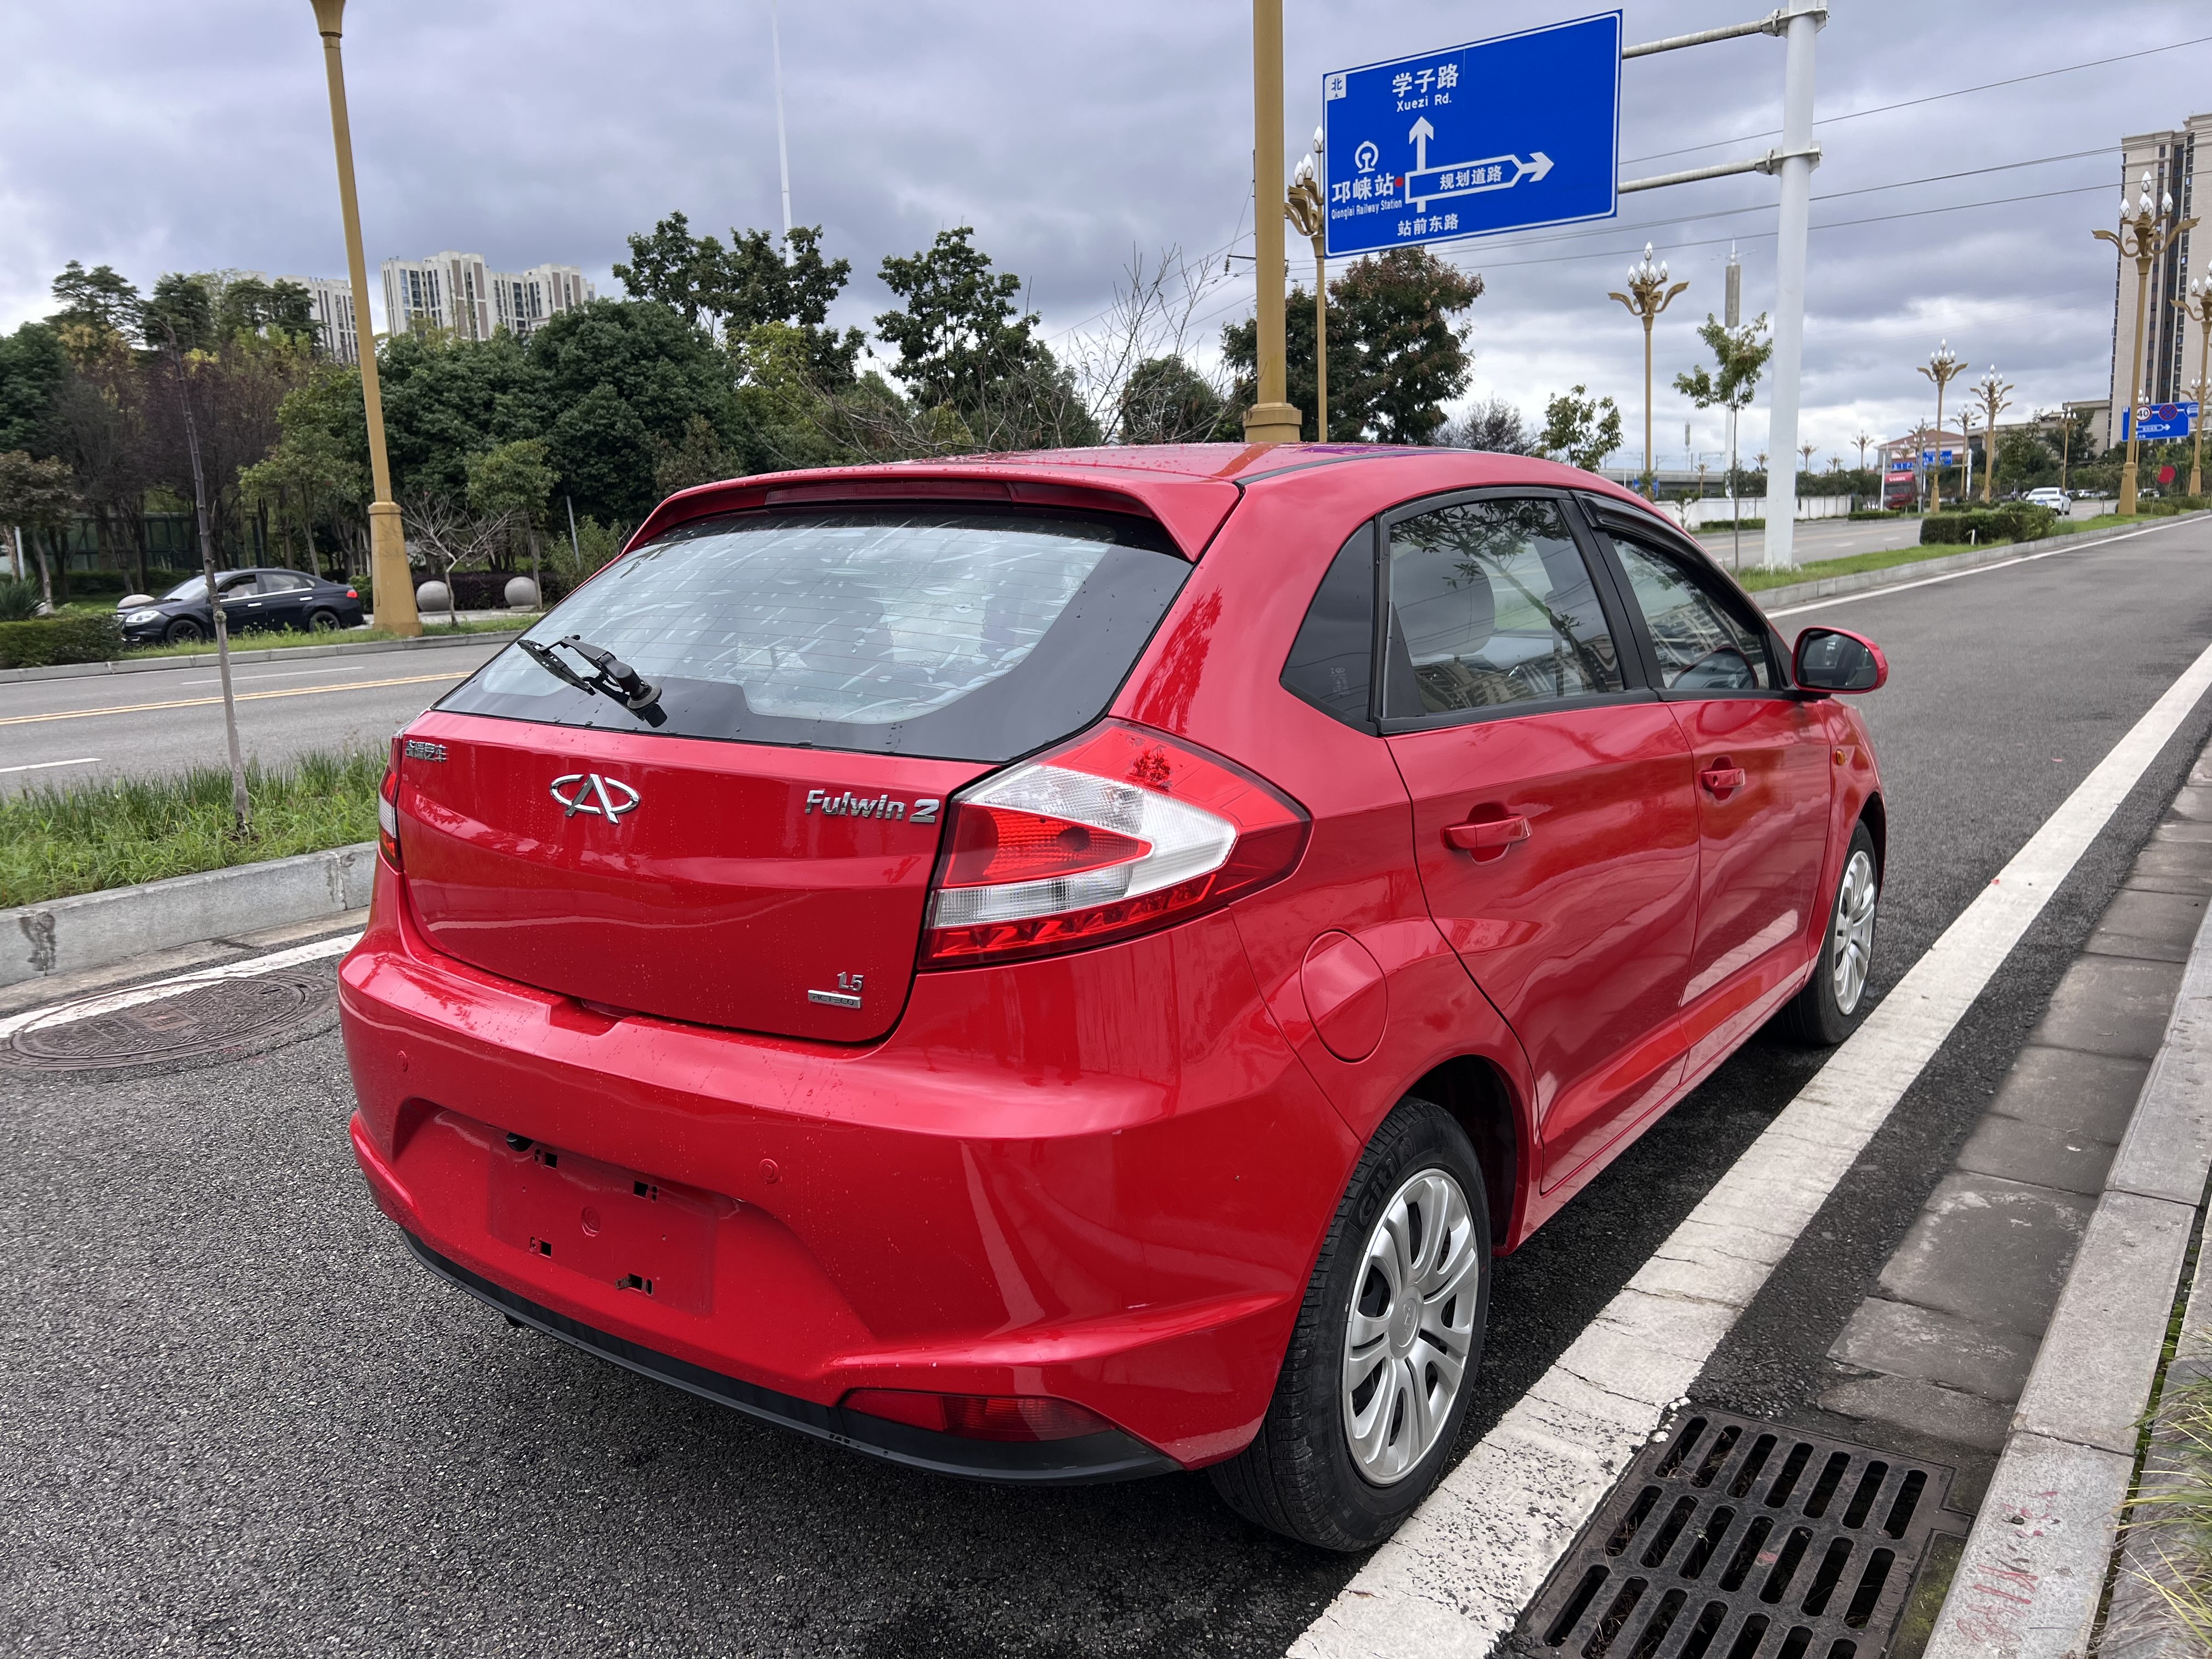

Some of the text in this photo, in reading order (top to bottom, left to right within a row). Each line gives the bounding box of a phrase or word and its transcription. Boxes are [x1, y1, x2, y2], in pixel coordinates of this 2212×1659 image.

[1331, 77, 1342, 92] 北
[1392, 63, 1459, 98] 学子路
[1396, 92, 1452, 112] Xuezi Rd.
[1331, 172, 1395, 204] 邛崃站
[1440, 165, 1503, 190] 规划道路
[1331, 198, 1403, 220] Qionglai Railway Station
[1397, 213, 1459, 236] 站前东路
[2137, 409, 2149, 417] 40
[804, 789, 941, 823] Fulwin 2
[813, 994, 854, 1006] ACTECO
[1359, 1158, 1398, 1226] Giti
